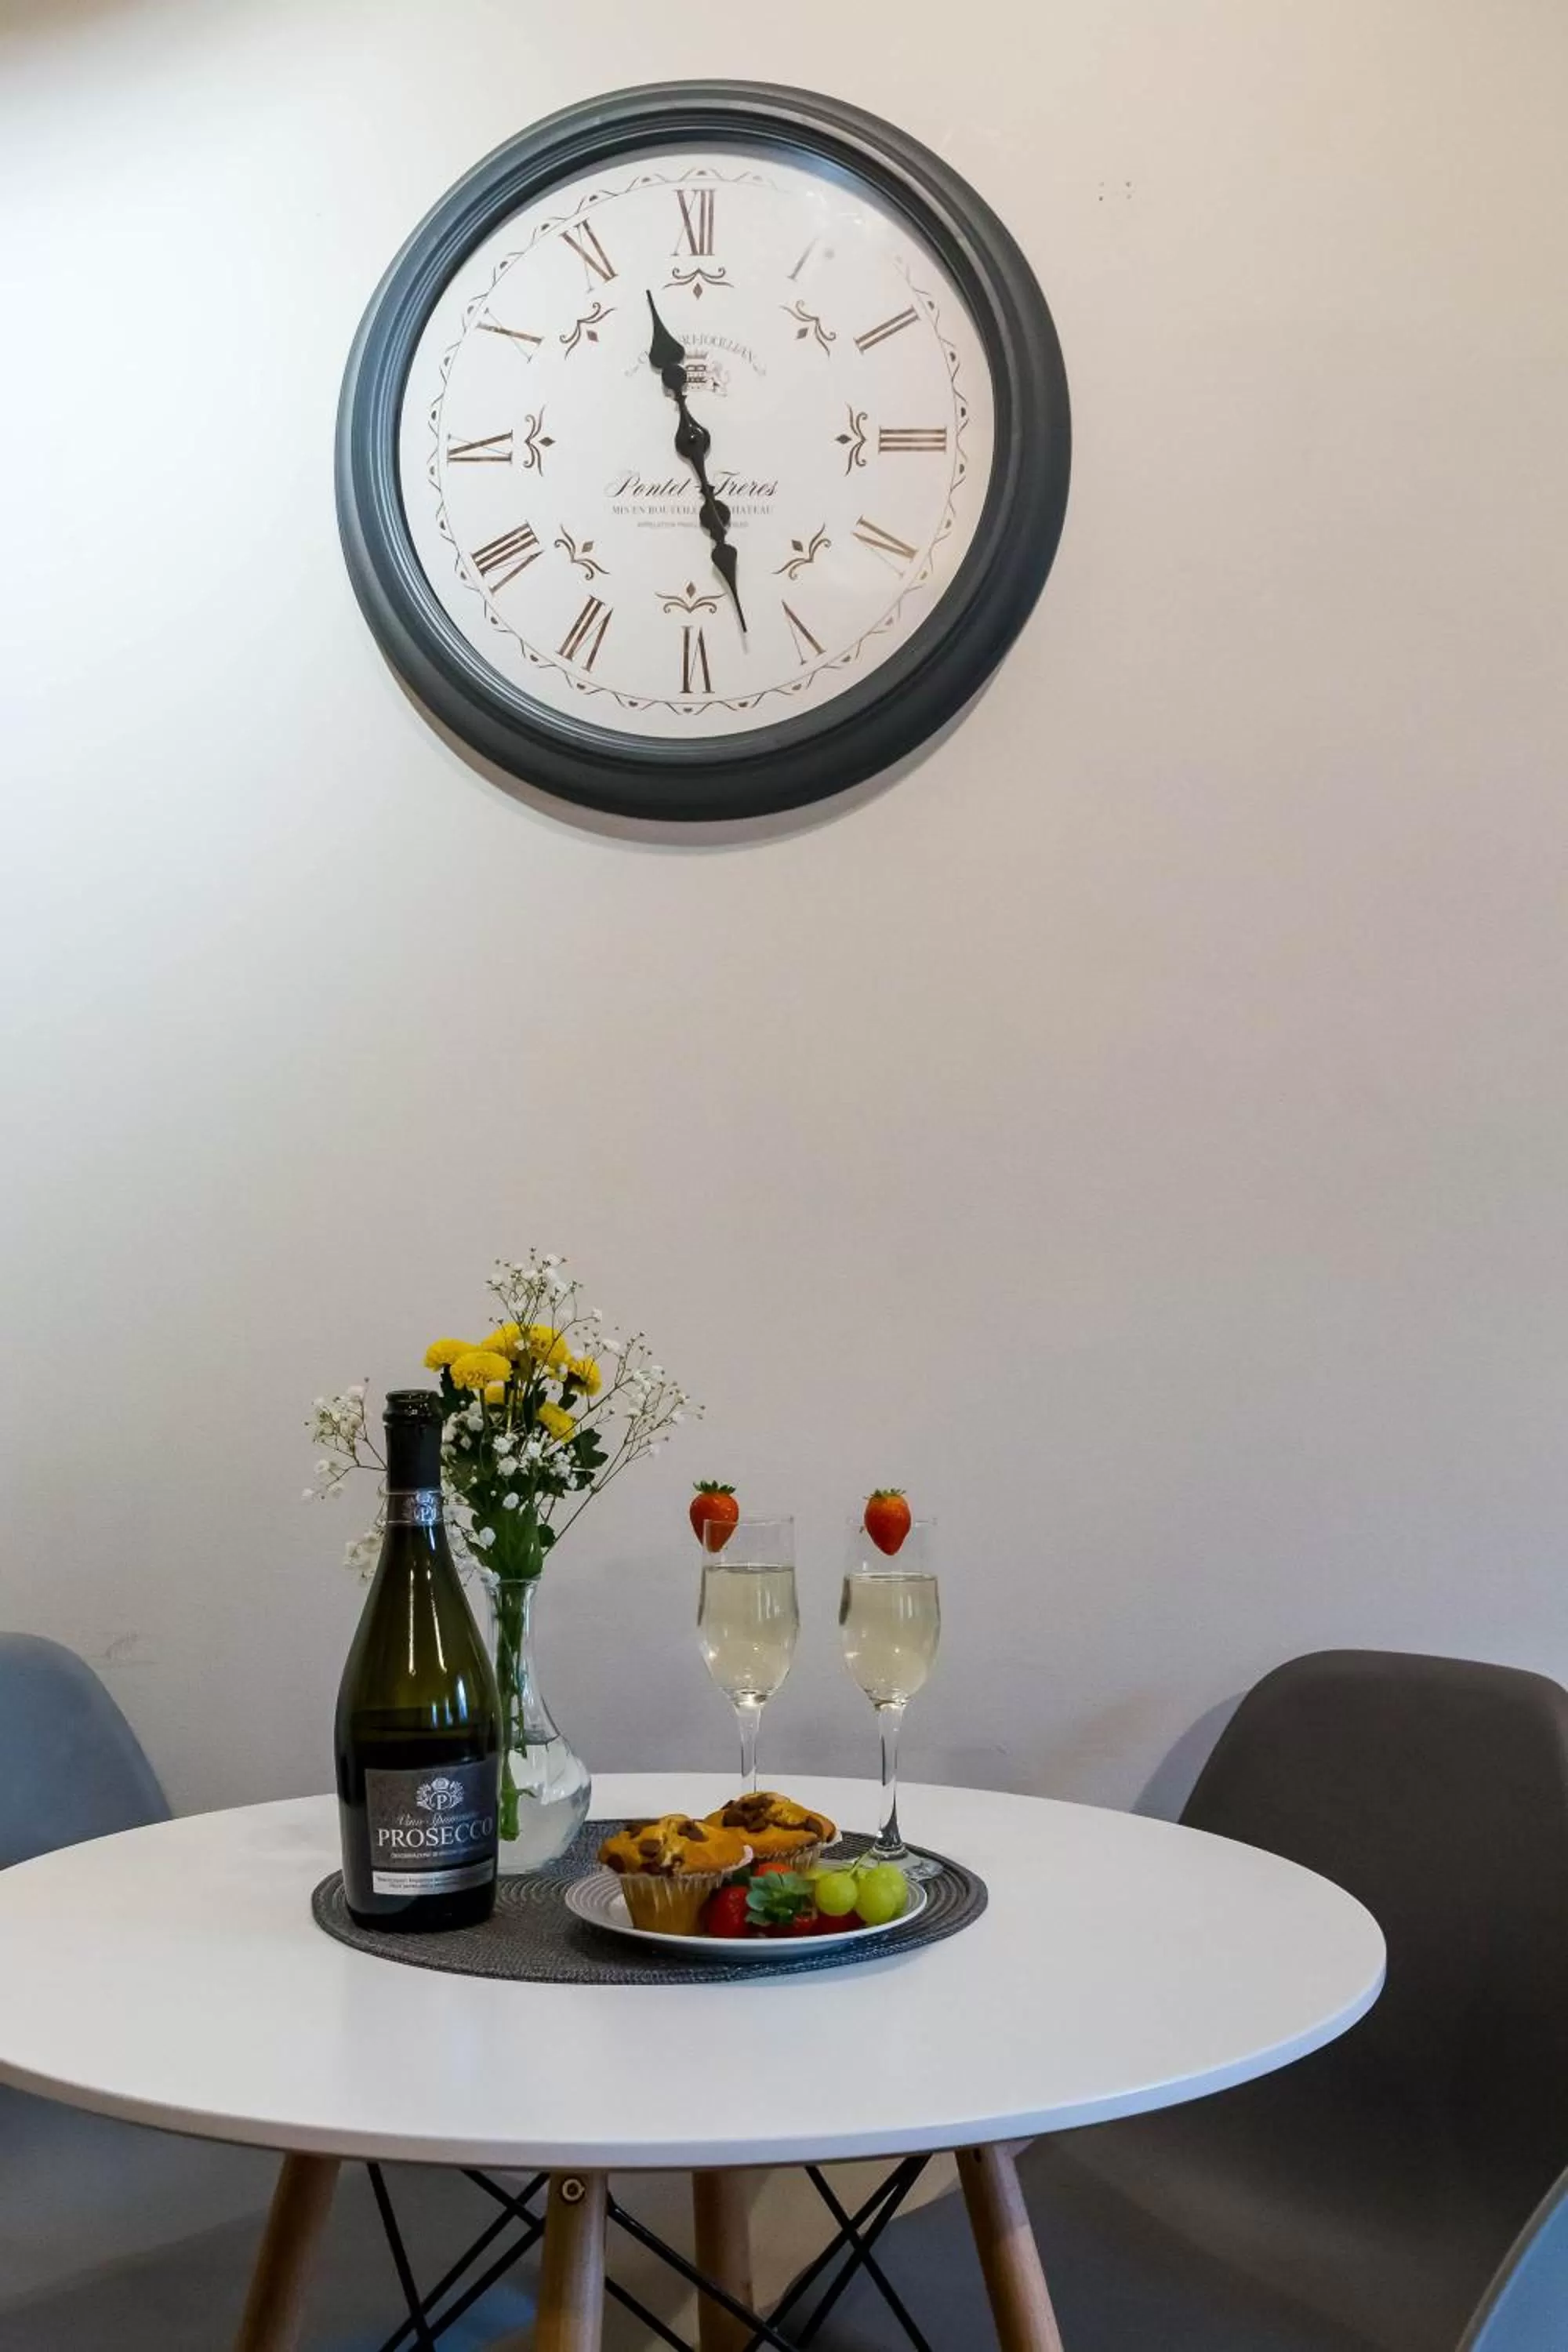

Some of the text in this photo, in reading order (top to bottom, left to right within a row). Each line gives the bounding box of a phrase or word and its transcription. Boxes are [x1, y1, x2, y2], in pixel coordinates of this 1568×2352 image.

[558, 219, 619, 293] XI
[671, 188, 717, 256] XII
[475, 307, 545, 364] X
[853, 304, 922, 356] II
[447, 428, 514, 465] IX
[877, 425, 947, 455] III
[470, 518, 546, 595] VIII
[555, 593, 614, 673] VII
[679, 625, 716, 695] VI
[781, 598, 826, 666] V
[377, 1817, 494, 1849] PROSECCO
